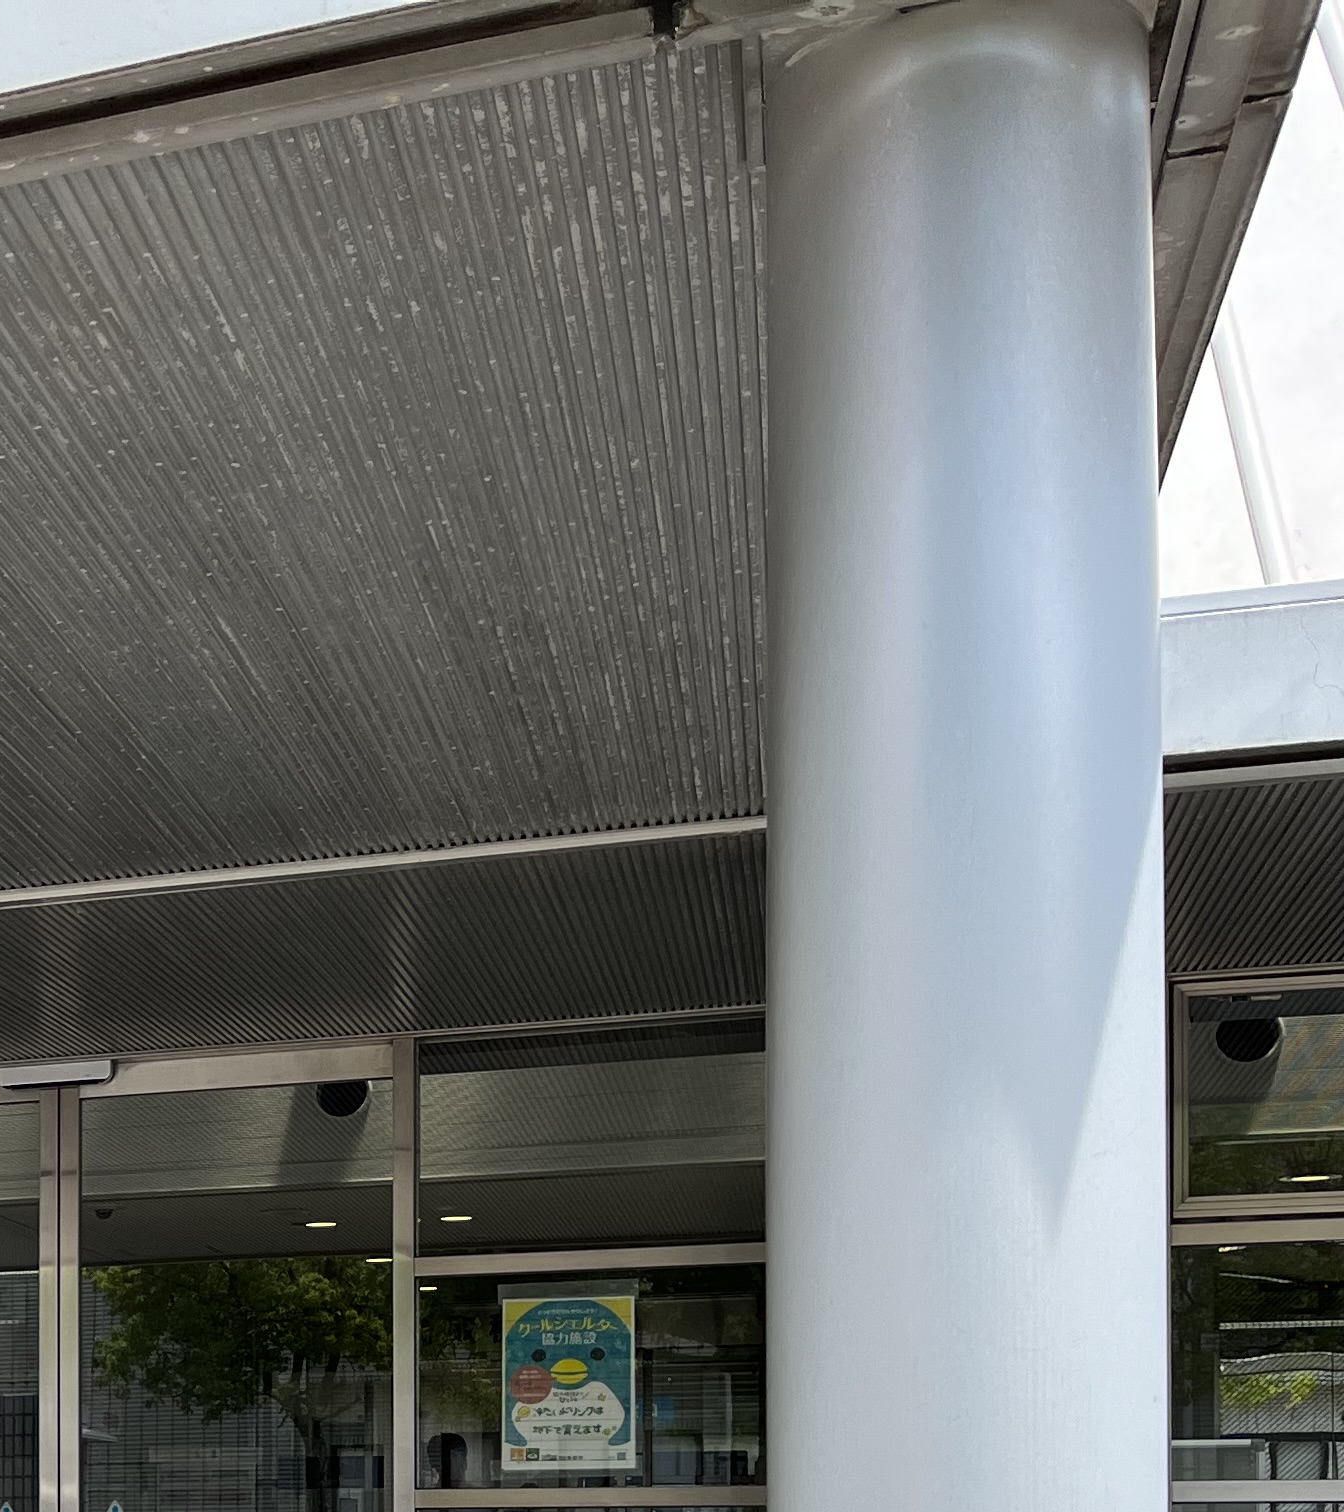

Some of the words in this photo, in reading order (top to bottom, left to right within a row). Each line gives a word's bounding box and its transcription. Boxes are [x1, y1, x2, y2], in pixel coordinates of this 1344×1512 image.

[519, 1317, 618, 1337] クールシェルター
[542, 1332, 597, 1345] 協力施設
